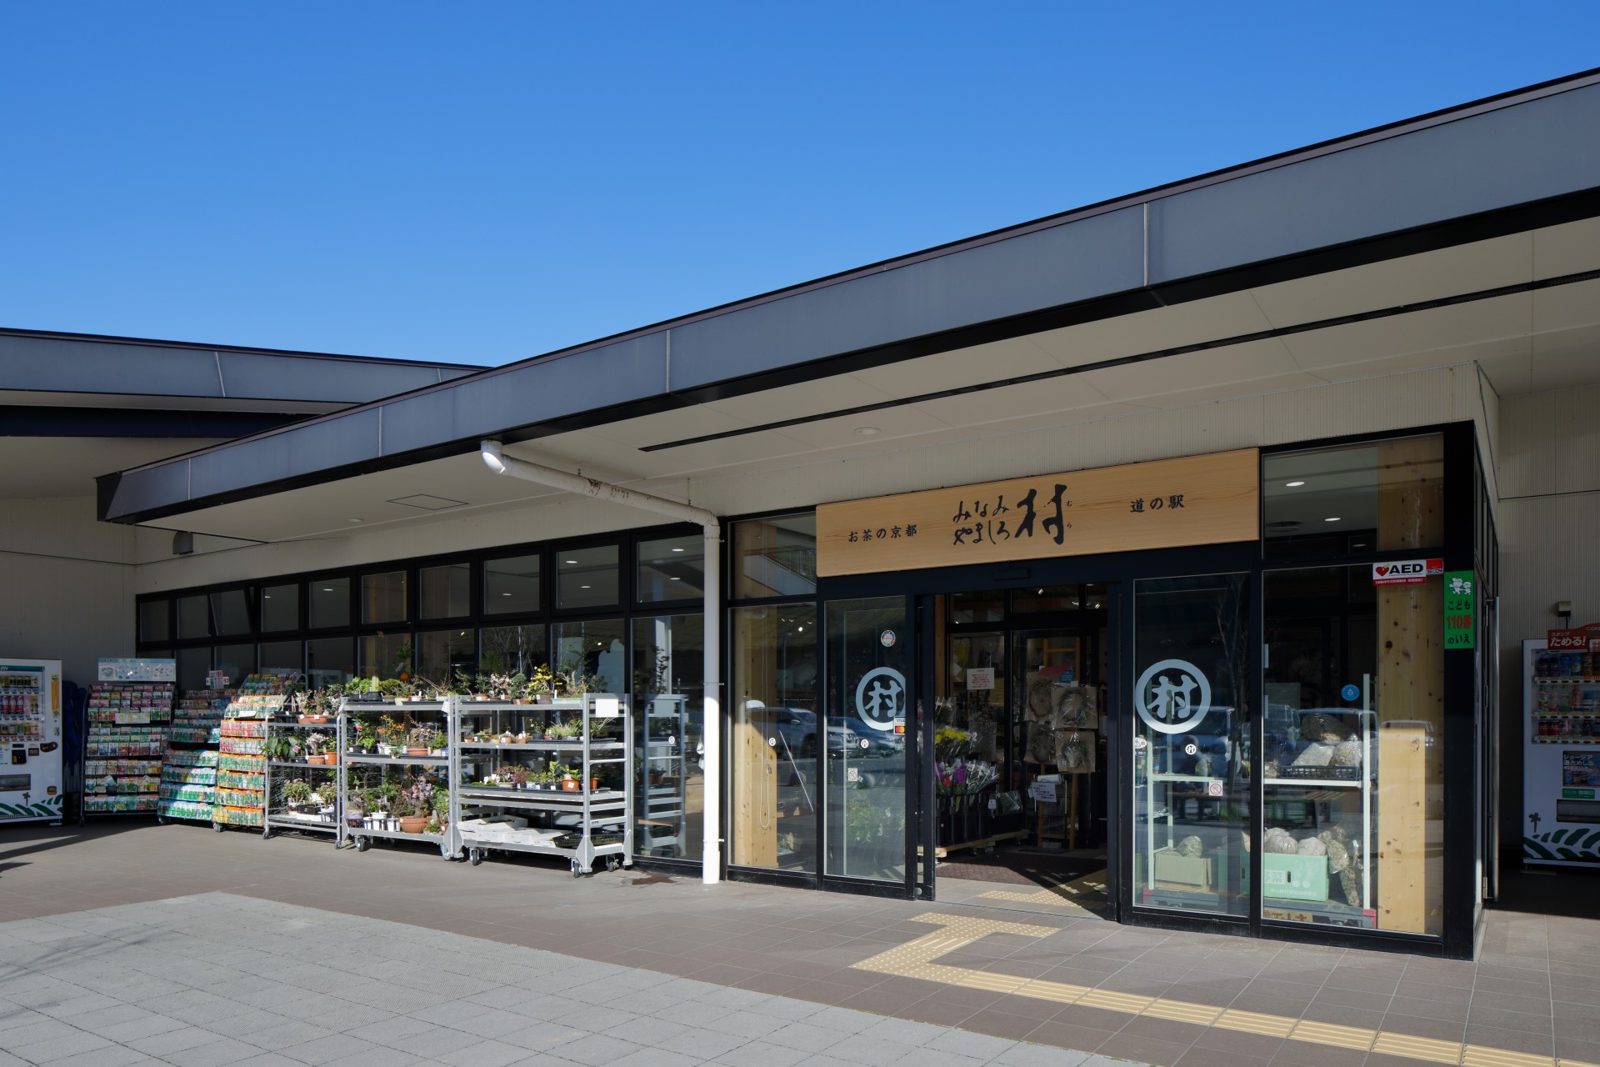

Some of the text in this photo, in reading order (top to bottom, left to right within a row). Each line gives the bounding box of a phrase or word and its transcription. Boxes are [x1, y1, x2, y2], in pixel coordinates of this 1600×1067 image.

[1014, 483, 1068, 545] 村
[1130, 494, 1186, 514] 道の駅
[848, 524, 918, 544] お茶の京都
[1389, 564, 1424, 573] AED
[1447, 600, 1471, 610] こども
[1447, 633, 1471, 644] のいえ
[1147, 674, 1198, 718] 村
